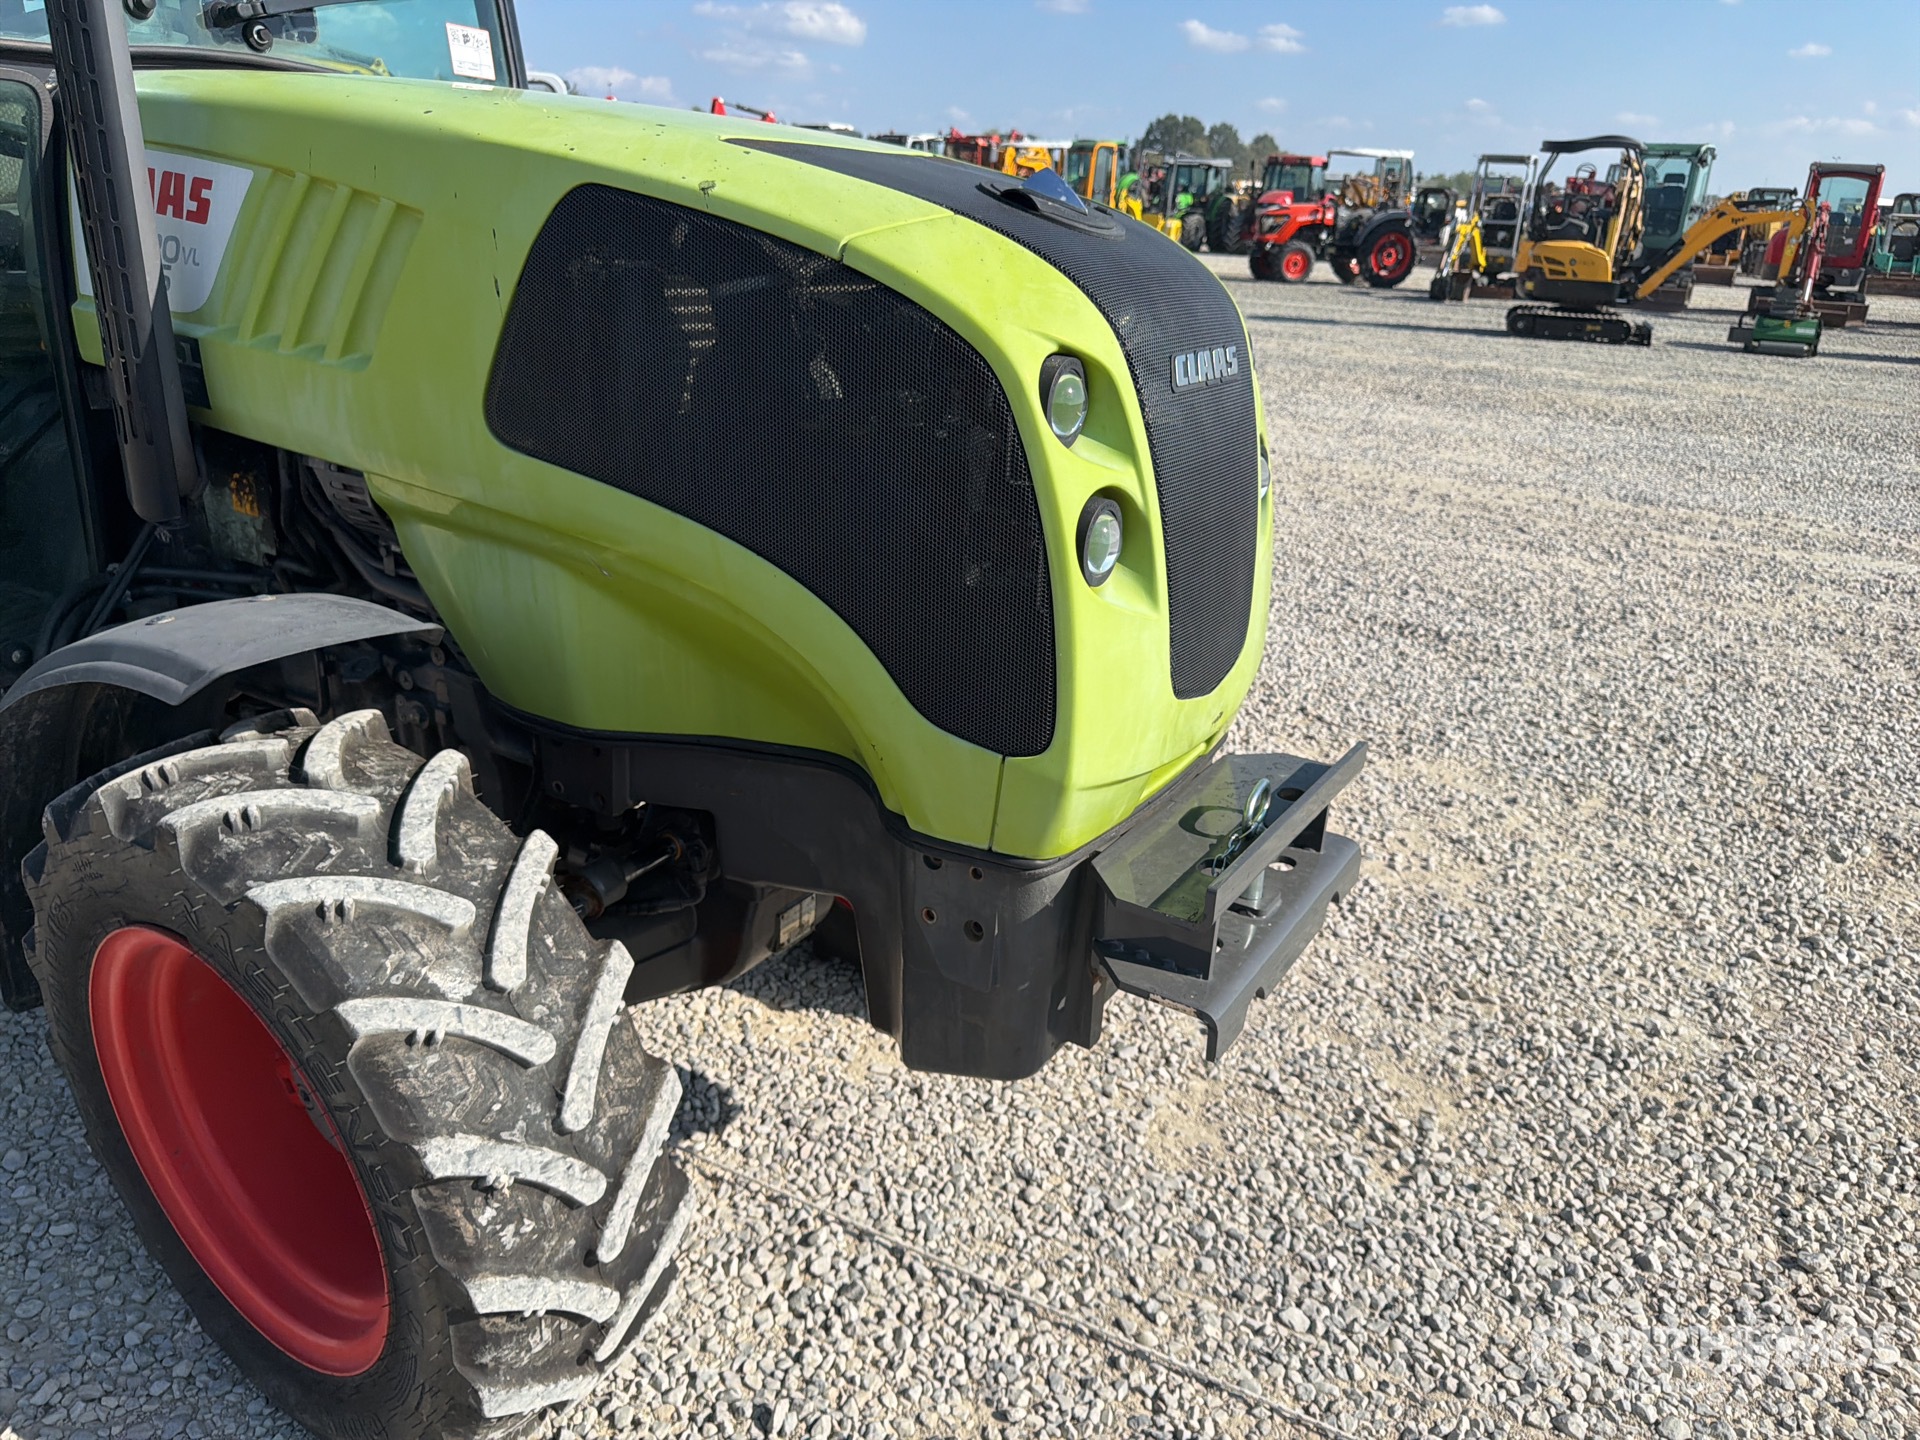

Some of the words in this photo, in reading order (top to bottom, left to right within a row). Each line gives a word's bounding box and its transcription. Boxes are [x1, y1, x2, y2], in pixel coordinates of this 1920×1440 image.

[148, 168, 213, 225] AS
[158, 233, 200, 267] 0VL
[1175, 346, 1239, 387] CLAAS
